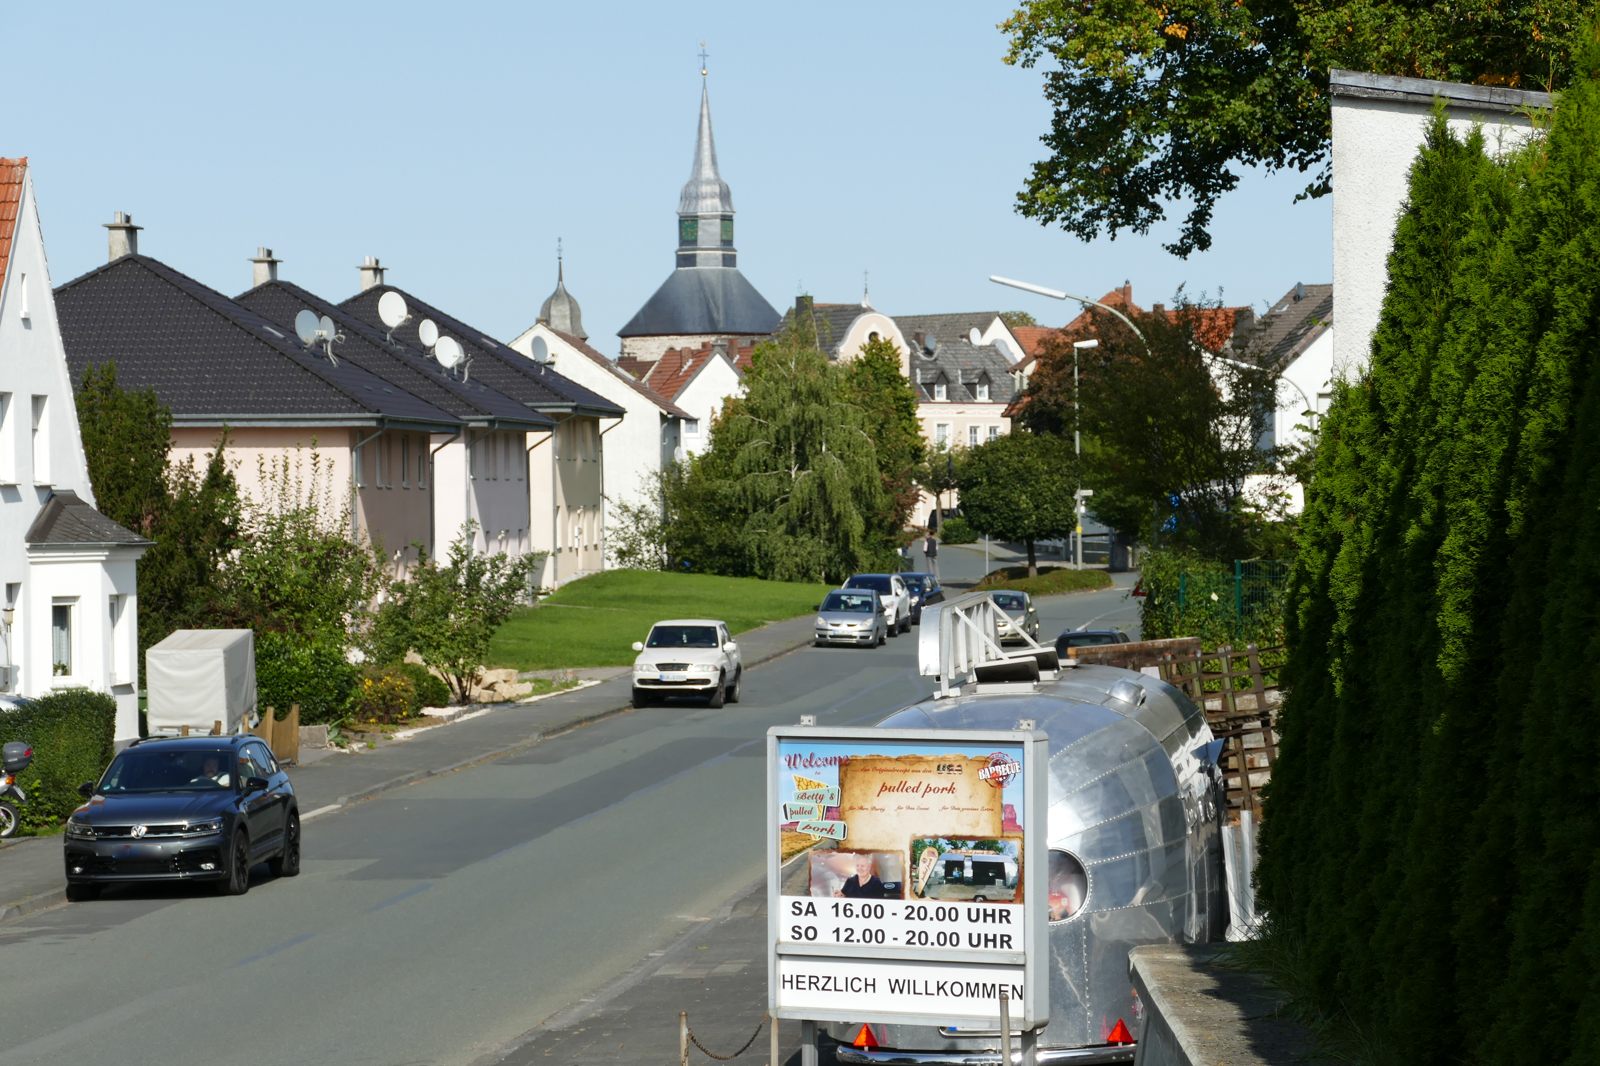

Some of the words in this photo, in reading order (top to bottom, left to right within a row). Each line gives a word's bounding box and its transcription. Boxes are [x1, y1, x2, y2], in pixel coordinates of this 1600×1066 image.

[785, 752, 849, 769] Welcome
[936, 763, 963, 775] USA
[876, 780, 922, 797] pulled
[921, 782, 956, 798] pork
[789, 806, 814, 819] pulled
[802, 823, 836, 835] pork
[791, 900, 818, 917] SA
[831, 902, 885, 920] 16.00
[904, 905, 959, 922] 20.00
[967, 907, 1012, 924] UHR
[791, 925, 818, 941] SO
[832, 927, 886, 944] 12.00
[905, 929, 960, 948] 20.00
[968, 932, 1013, 950] UHR
[782, 974, 876, 993] HERZLICH
[888, 978, 1024, 1001] WILLKOMMEN
